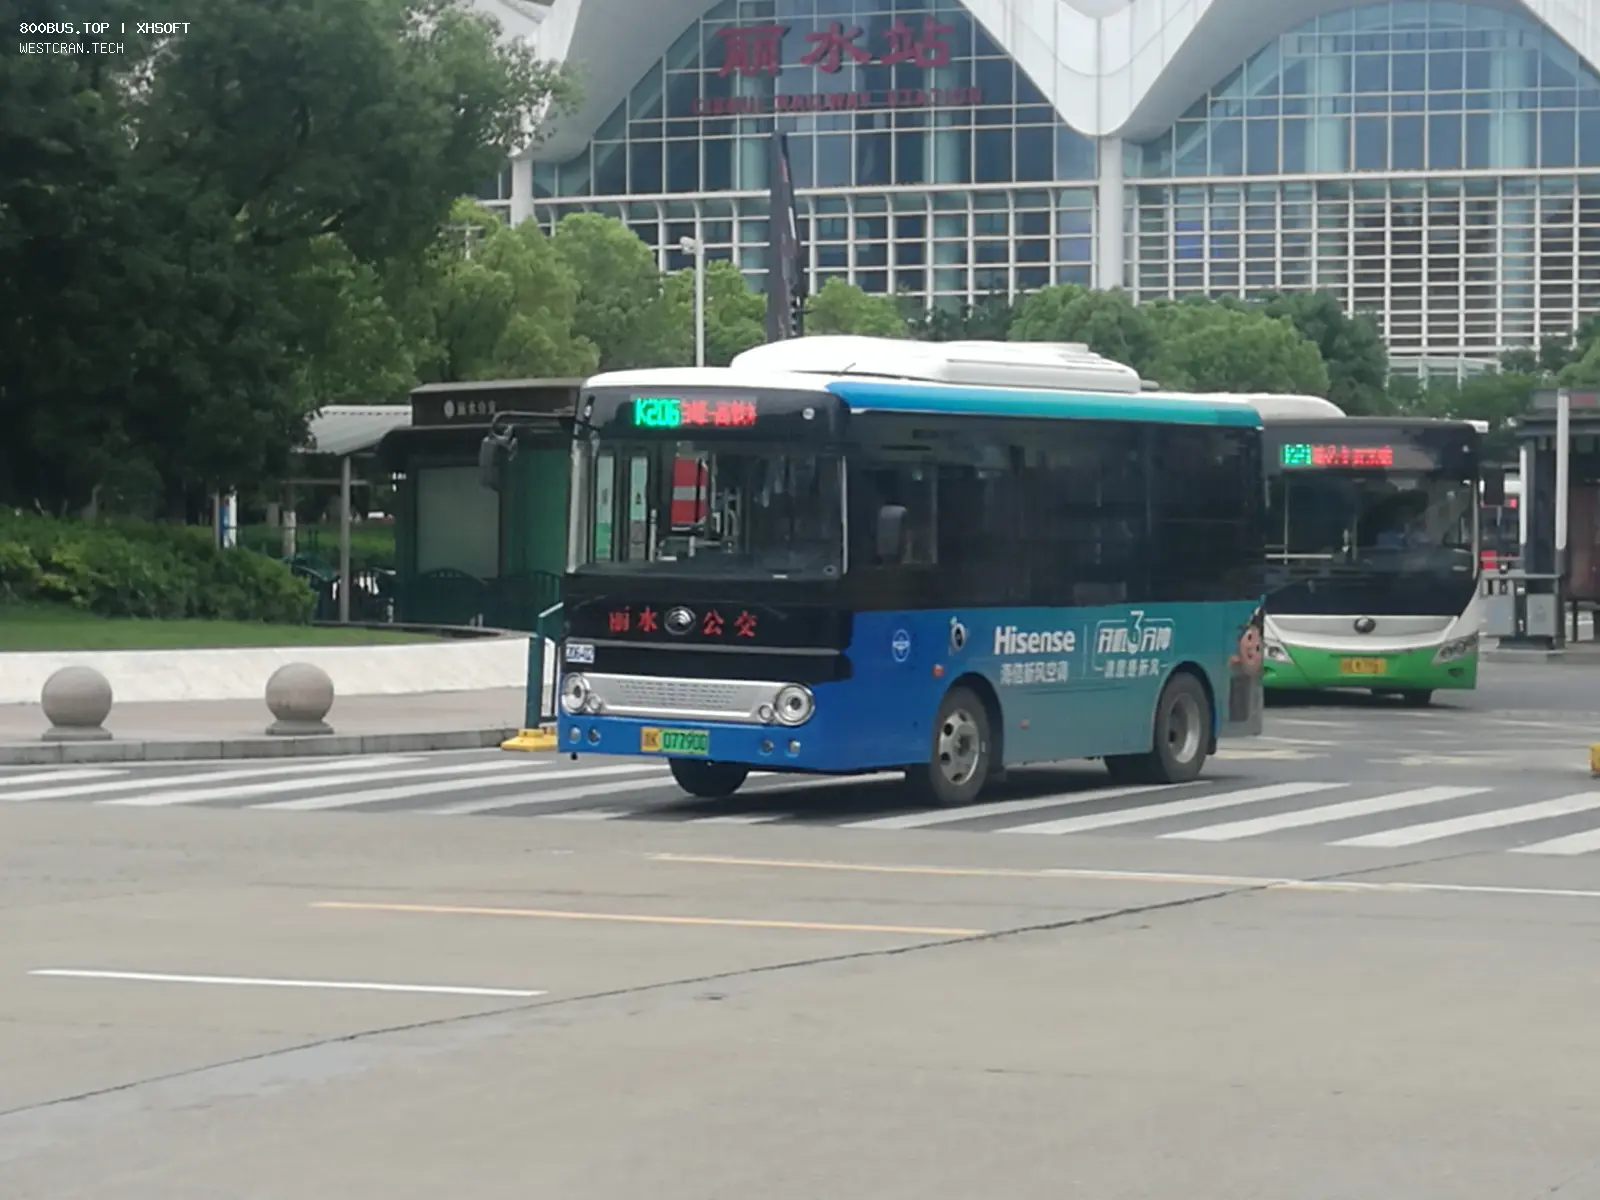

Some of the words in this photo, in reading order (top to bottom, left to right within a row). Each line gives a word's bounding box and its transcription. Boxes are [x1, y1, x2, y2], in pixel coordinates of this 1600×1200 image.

[716, 15, 954, 77] 丽水站
[608, 606, 658, 633] 丽水
[703, 609, 758, 637] 公交
[993, 625, 1076, 656] Hisense
